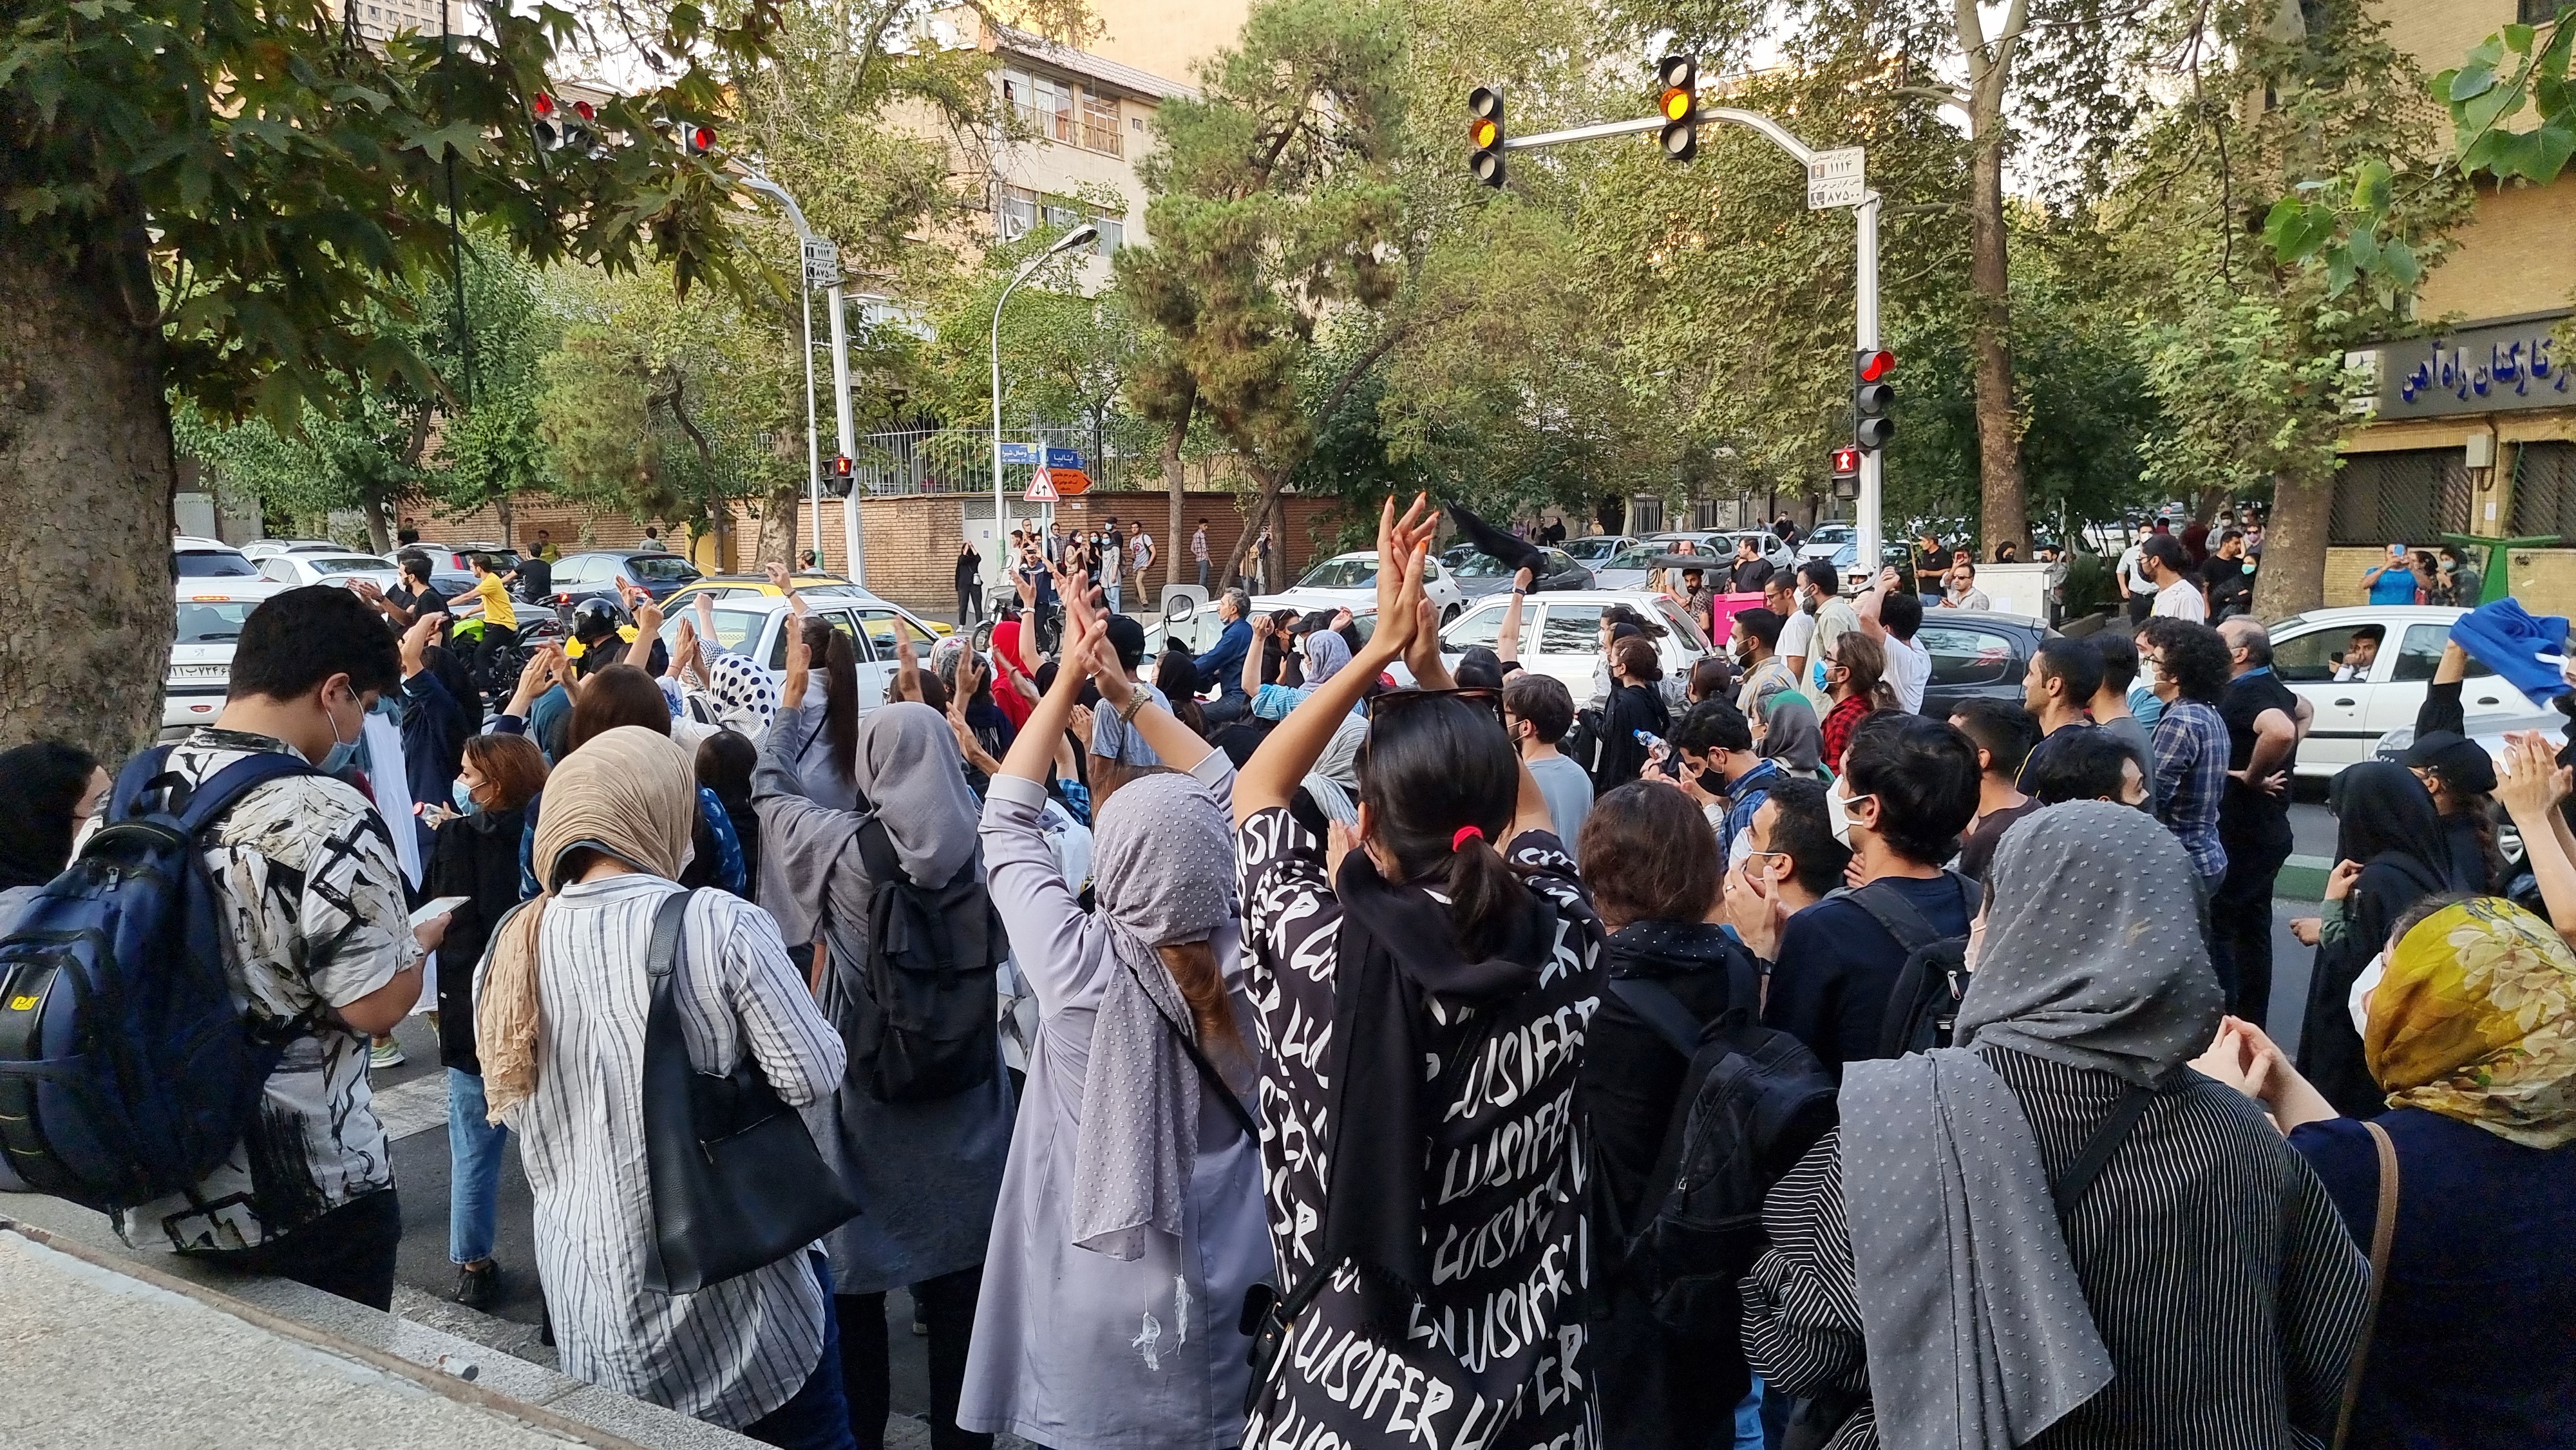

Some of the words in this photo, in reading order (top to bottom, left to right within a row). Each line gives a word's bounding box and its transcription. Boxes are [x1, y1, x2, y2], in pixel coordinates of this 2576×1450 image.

[1830, 160, 1852, 173] ۱۱۱۴
[1828, 190, 1860, 203] ۸۷۵۰۰
[818, 249, 830, 257] ۱۱۱۴
[1294, 1306, 1454, 1450] LUSIFER
